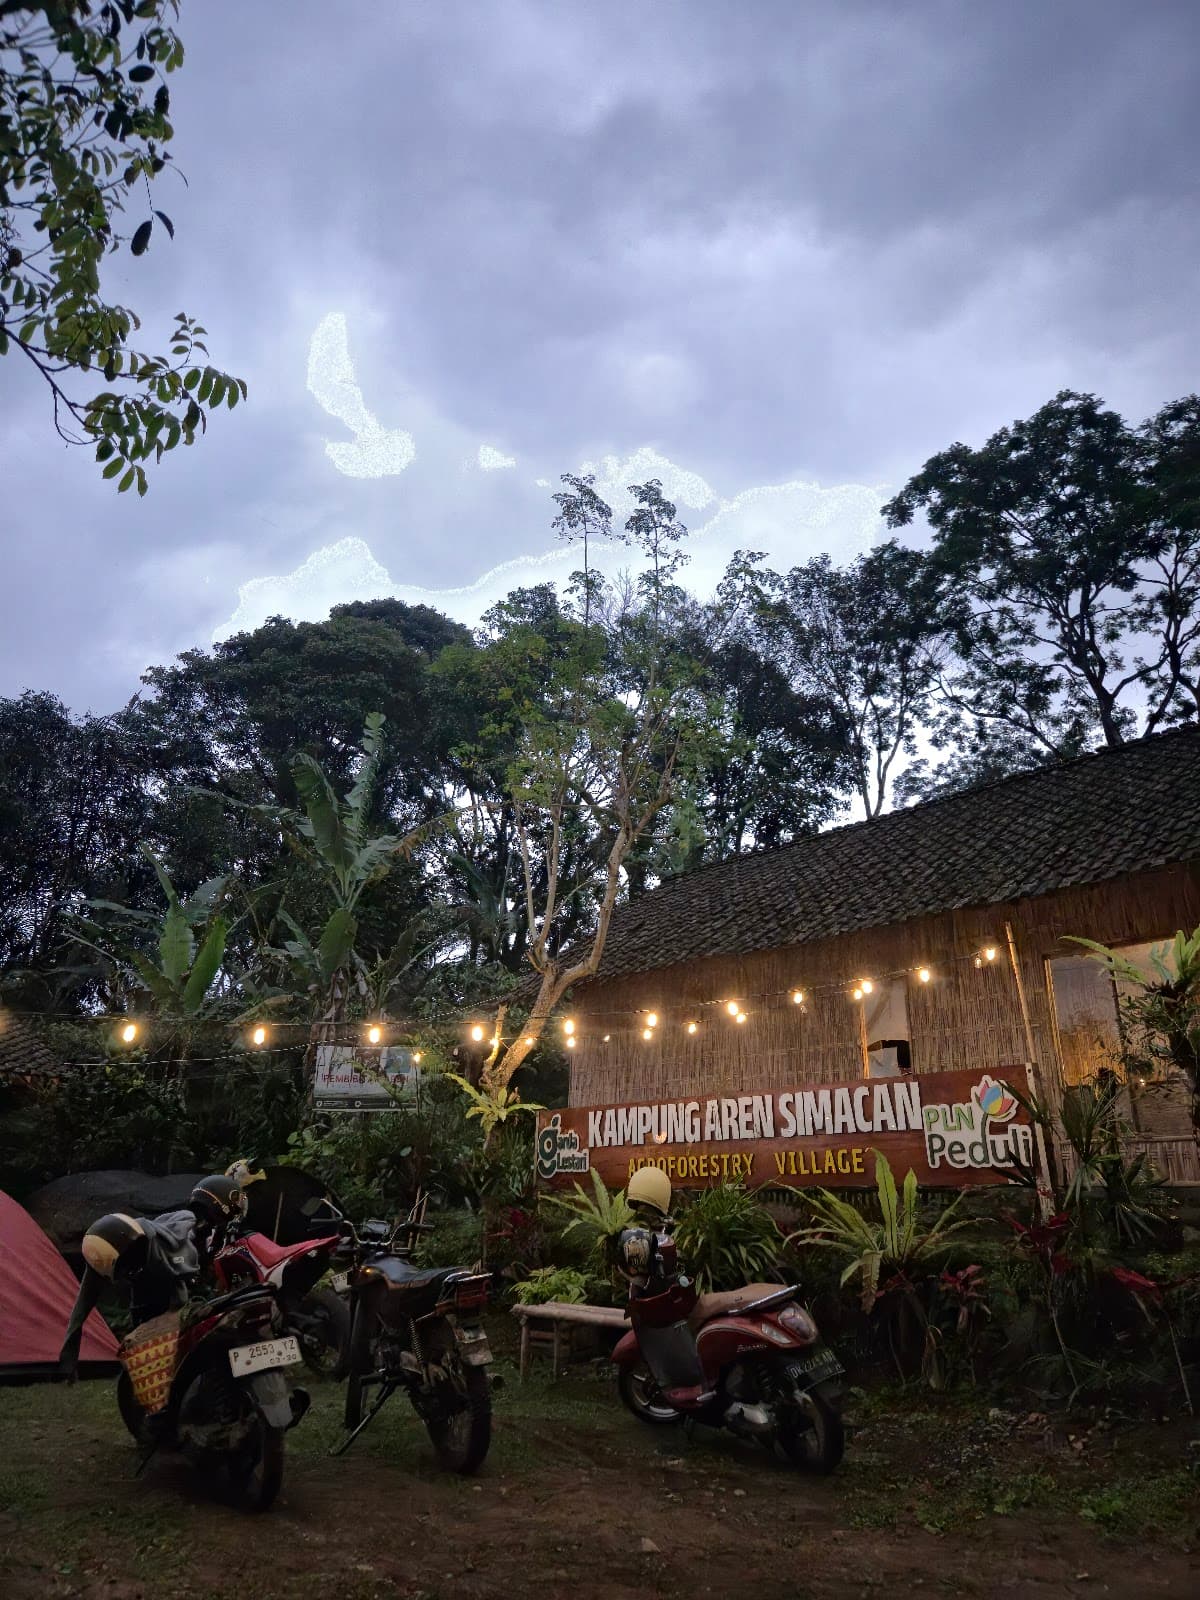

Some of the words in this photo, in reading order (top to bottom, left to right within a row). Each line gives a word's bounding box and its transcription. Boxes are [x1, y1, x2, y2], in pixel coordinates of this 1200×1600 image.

[588, 1101, 701, 1148] KAMPUNG
[704, 1094, 775, 1141] AREN
[778, 1081, 923, 1138] SIMACAN
[924, 1105, 975, 1132] PLN
[556, 1152, 587, 1170] Lestari
[927, 1127, 1032, 1168] Peduli
[774, 1149, 865, 1175] VILLAGE
